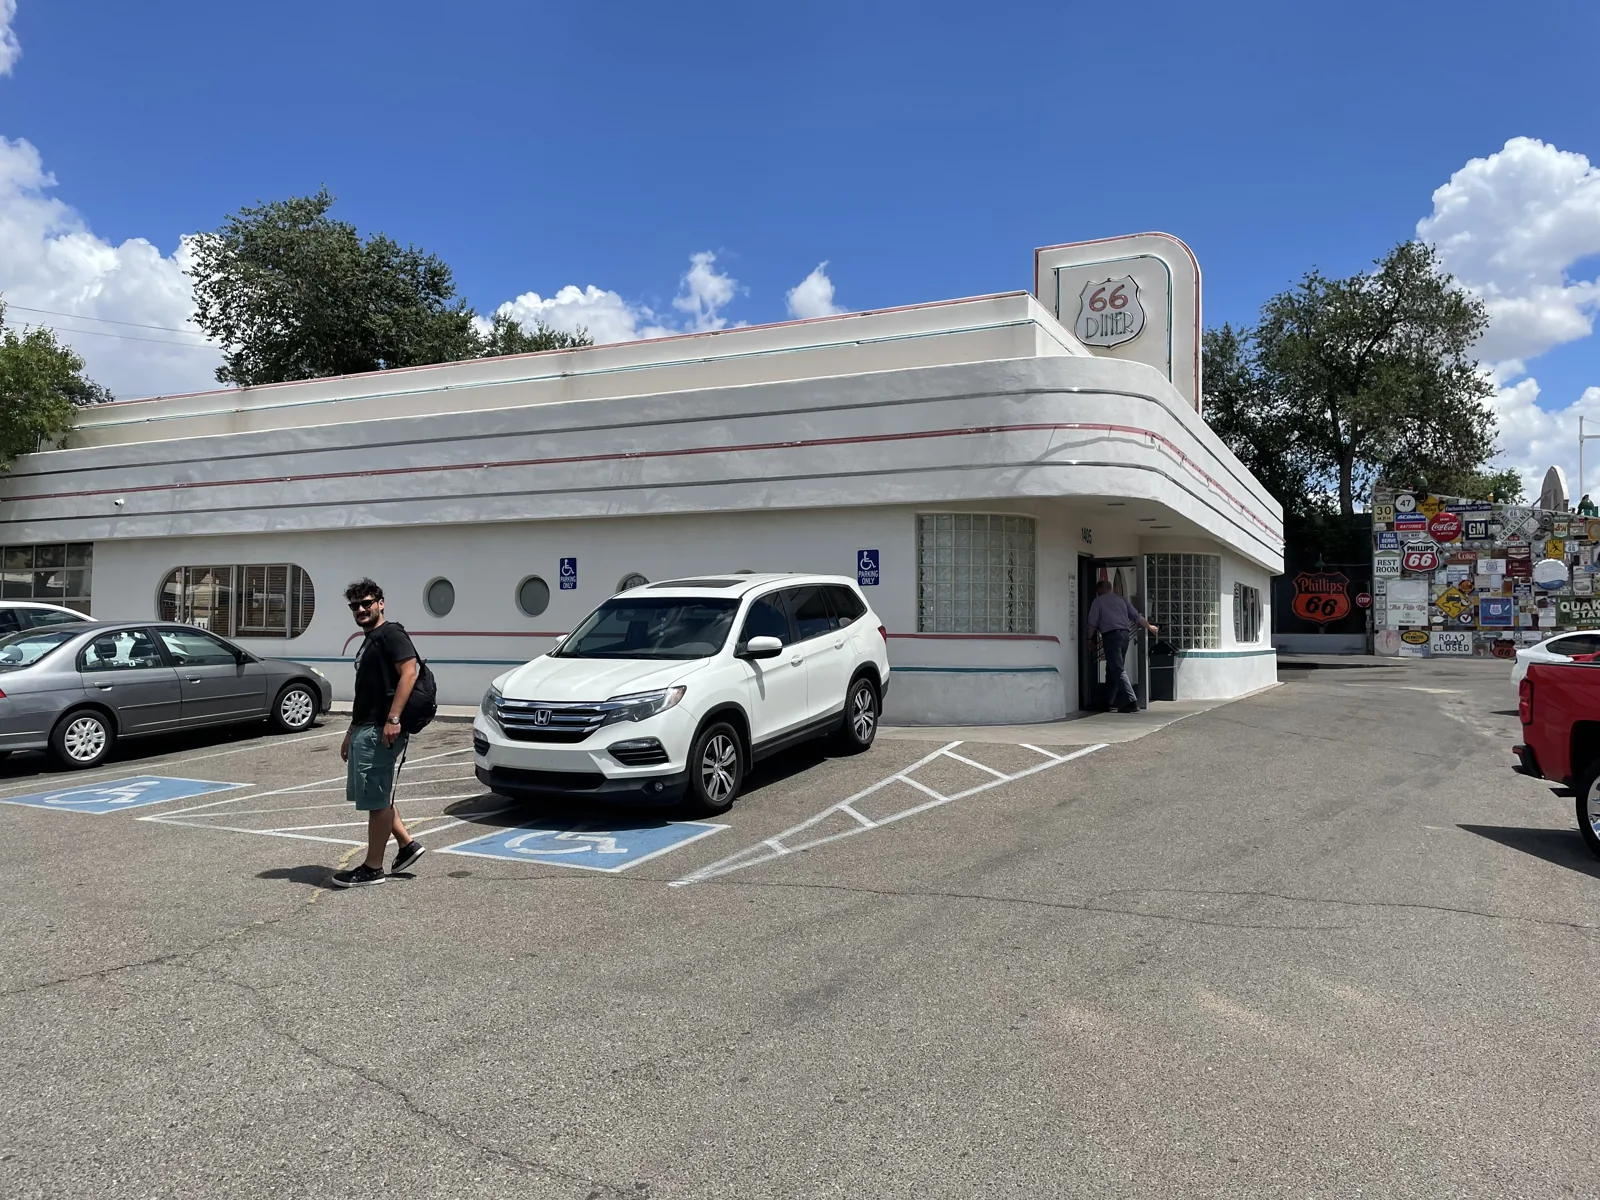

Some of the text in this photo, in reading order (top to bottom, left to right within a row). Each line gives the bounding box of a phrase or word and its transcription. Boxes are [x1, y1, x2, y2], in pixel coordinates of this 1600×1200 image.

[1089, 284, 1129, 312] 66
[1085, 311, 1134, 339] DINER
[1376, 506, 1391, 515] 30
[1431, 521, 1459, 531] Coca-Cola
[1468, 522, 1485, 535] GM
[1499, 511, 1530, 540] CROSSING
[1081, 527, 1092, 545] 1405
[1408, 554, 1433, 567] 66
[1457, 552, 1476, 560] Coke
[857, 570, 879, 578] PARKING
[861, 577, 875, 585] ONLY
[1299, 577, 1344, 595] Phillips
[1305, 596, 1338, 616] 66
[1439, 633, 1465, 642] ROAD
[1433, 643, 1470, 652] CLOSED
